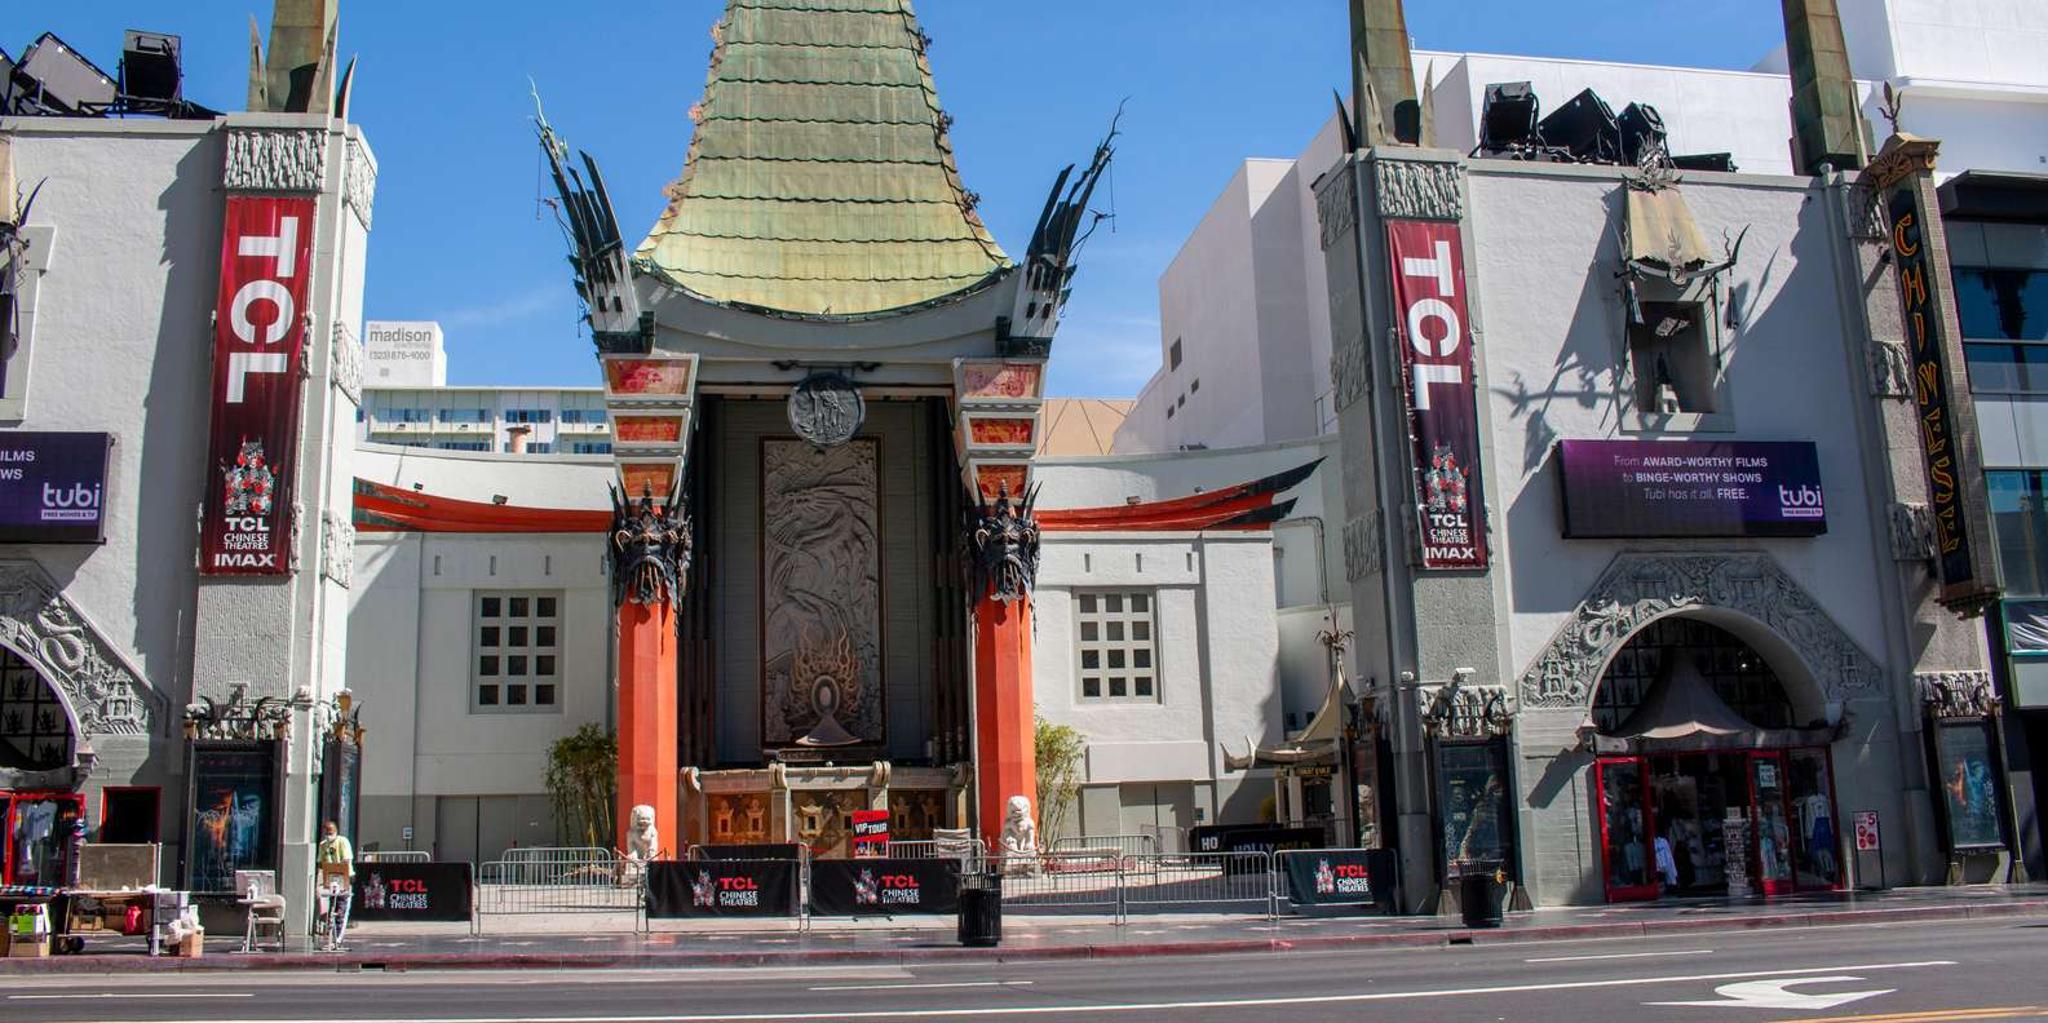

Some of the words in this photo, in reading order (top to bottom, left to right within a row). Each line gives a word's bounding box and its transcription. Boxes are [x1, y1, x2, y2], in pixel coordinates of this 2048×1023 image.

[226, 216, 298, 403] TCL
[1403, 240, 1462, 410] TCL
[370, 328, 432, 341] madison
[1895, 213, 1960, 554] CHINESE
[1614, 455, 1639, 466] From
[1643, 457, 1732, 467] AWARD-WORTHY
[1736, 457, 1768, 467] FILMS
[1623, 473, 1634, 482] to
[1636, 473, 1719, 483] BINGE-WORTHY
[1723, 473, 1762, 483] SHOWS
[43, 482, 100, 507] tubi
[1644, 488, 1665, 499] Tubi
[1668, 488, 1687, 499] has
[1717, 488, 1749, 499] FREE.
[1778, 484, 1822, 506] tubi
[224, 516, 270, 532] TCL
[1430, 513, 1468, 527] TCL
[223, 533, 269, 542] CHINESE
[1430, 528, 1468, 537] CHINESE
[224, 541, 269, 550] THEATRES
[1431, 536, 1469, 544] THEATRES
[1424, 547, 1475, 559] IMAX
[213, 553, 275, 567] IMAX
[855, 822, 868, 834] VIP
[868, 822, 887, 835] TOUR
[1336, 865, 1367, 877] TCL
[391, 880, 428, 892] TCL
[720, 877, 758, 890] TCL
[881, 875, 919, 888] TCL
[1336, 878, 1368, 886] CHINESE
[390, 893, 427, 902] CHINESE
[720, 890, 758, 899] CHINESE
[882, 888, 919, 897] CHINESE
[390, 901, 428, 909] THEATRES
